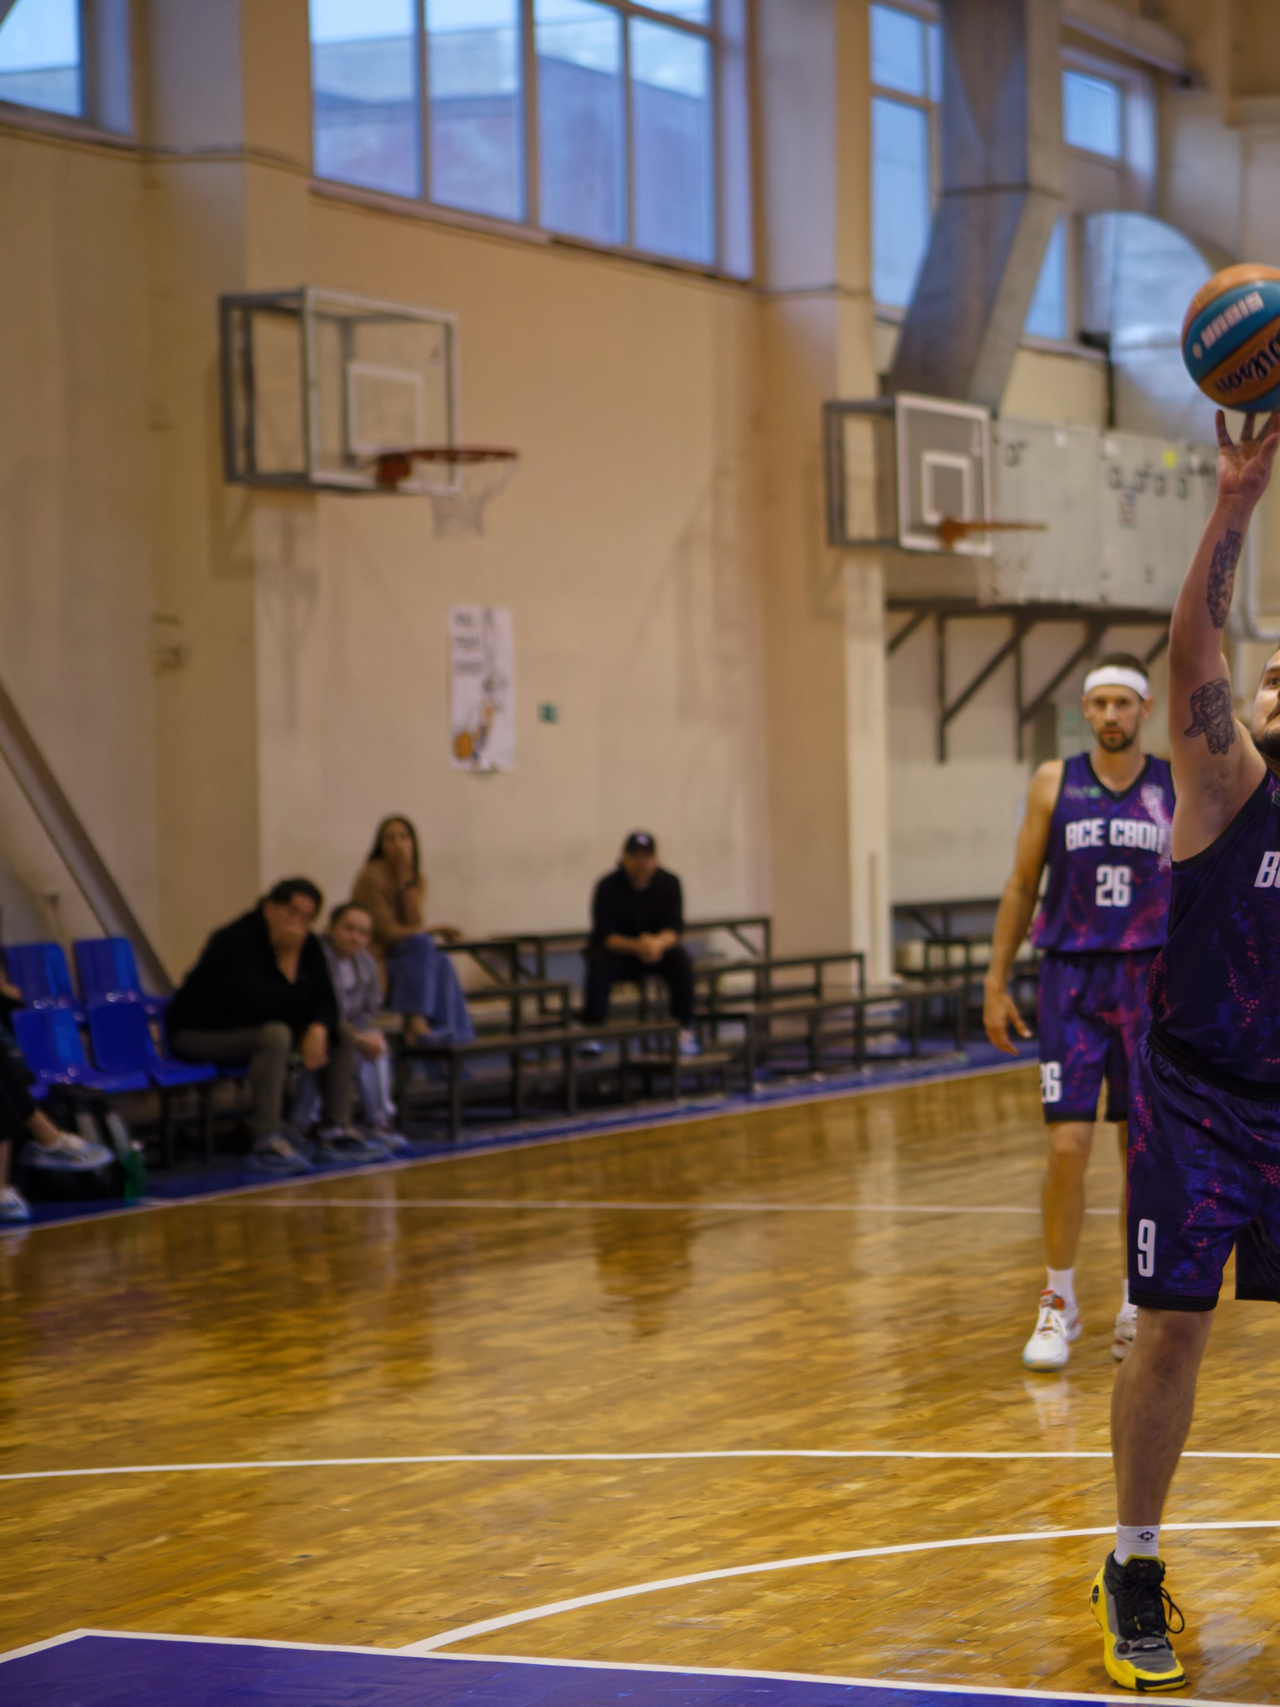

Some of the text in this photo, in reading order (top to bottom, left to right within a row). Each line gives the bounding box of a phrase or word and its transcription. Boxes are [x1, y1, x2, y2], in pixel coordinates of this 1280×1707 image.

[1065, 817, 1163, 855] ВСЕ СВОИ
[1096, 865, 1131, 907] 26
[1137, 1218, 1156, 1278] 9
